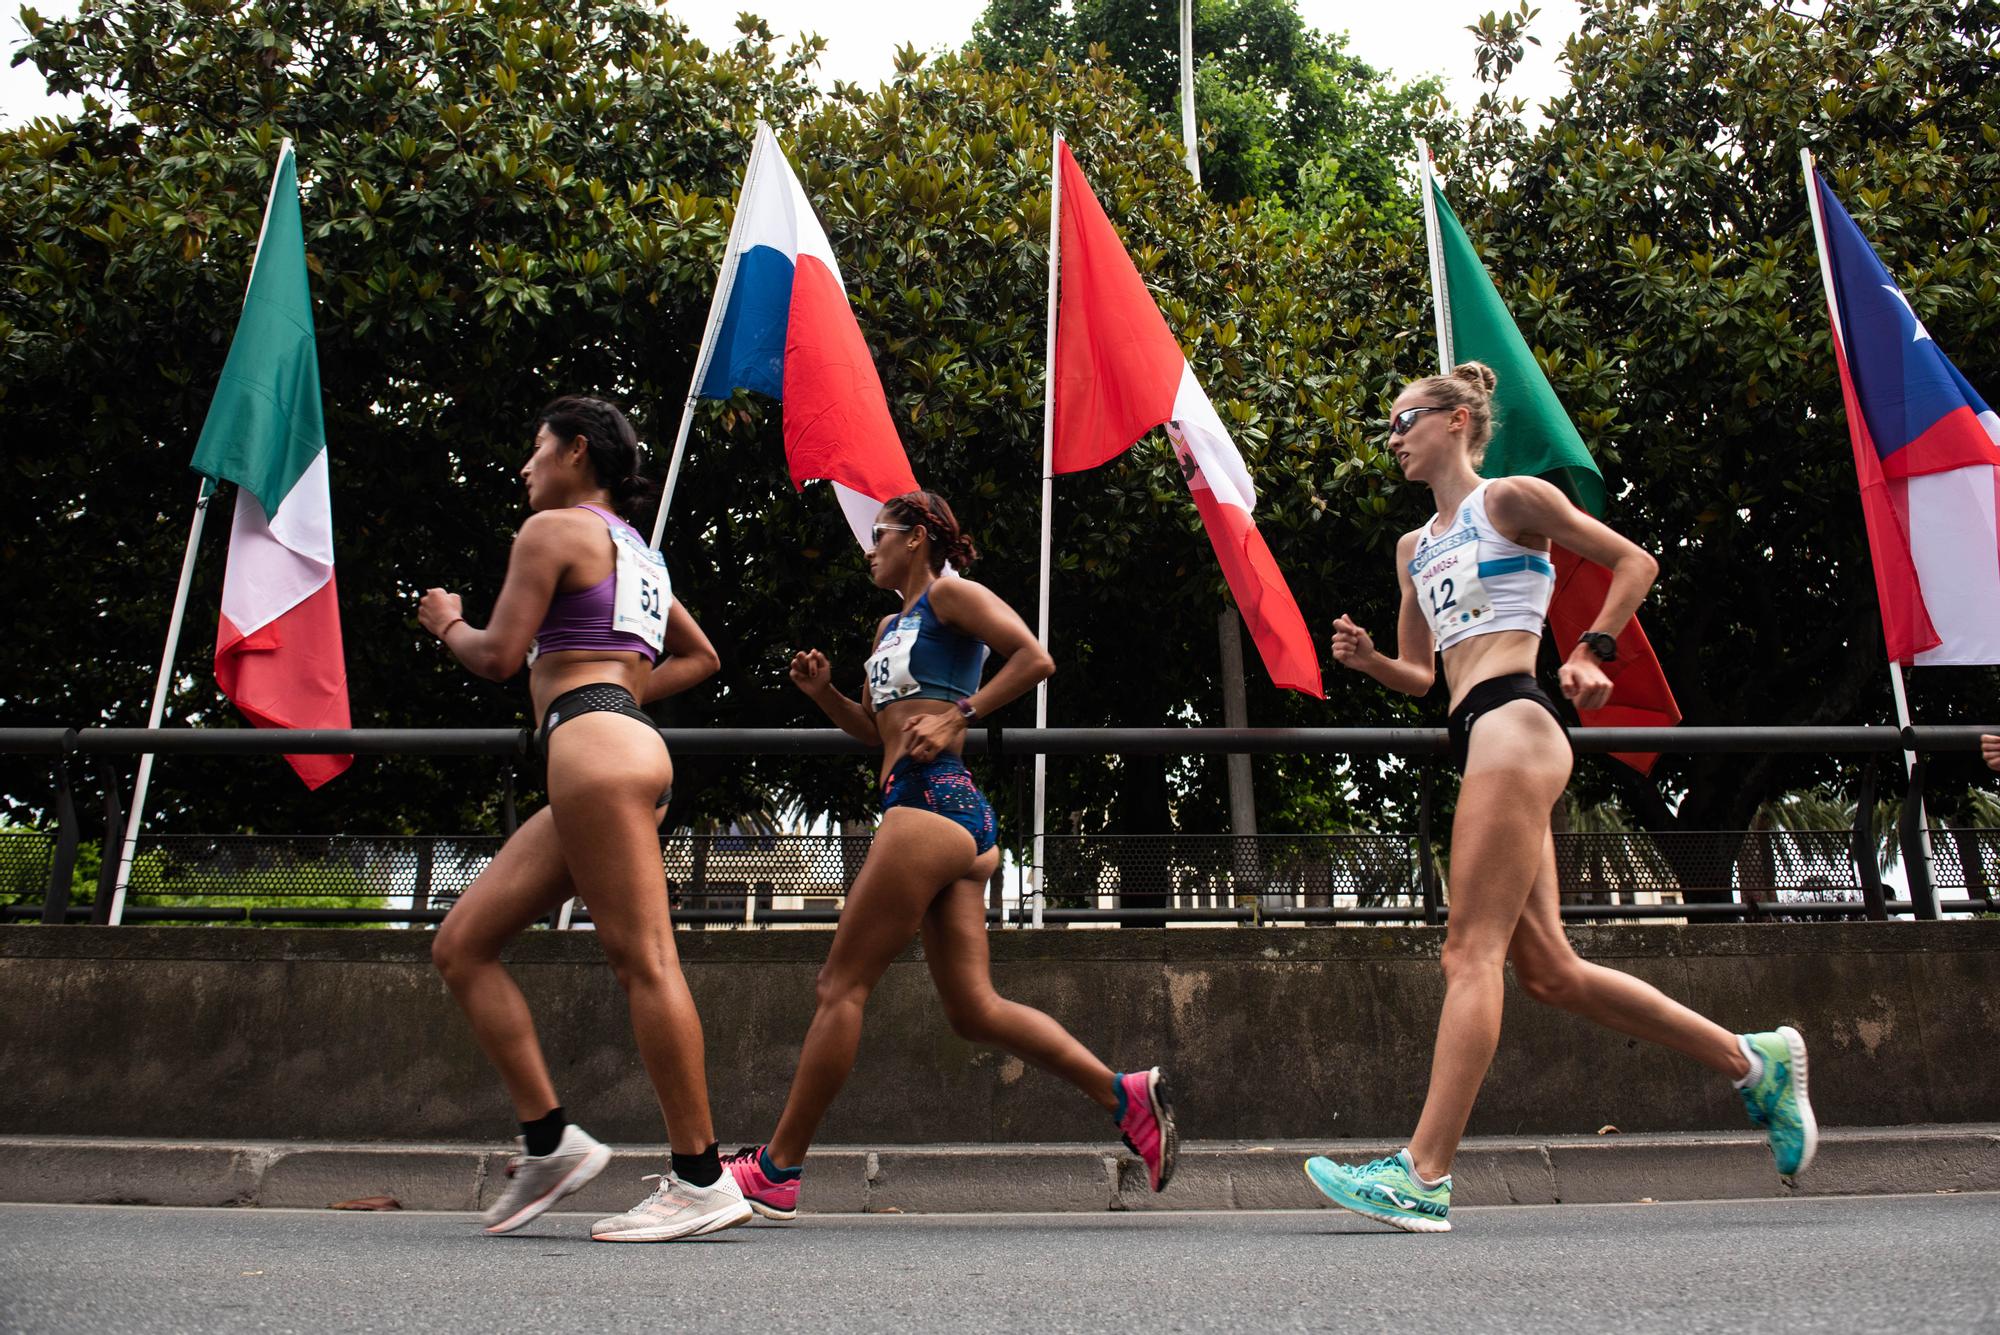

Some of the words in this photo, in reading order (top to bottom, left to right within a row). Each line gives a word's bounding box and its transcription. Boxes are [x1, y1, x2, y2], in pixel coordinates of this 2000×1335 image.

[641, 578, 661, 620] 51
[1430, 578, 1457, 616] 12
[871, 657, 889, 688] 48
